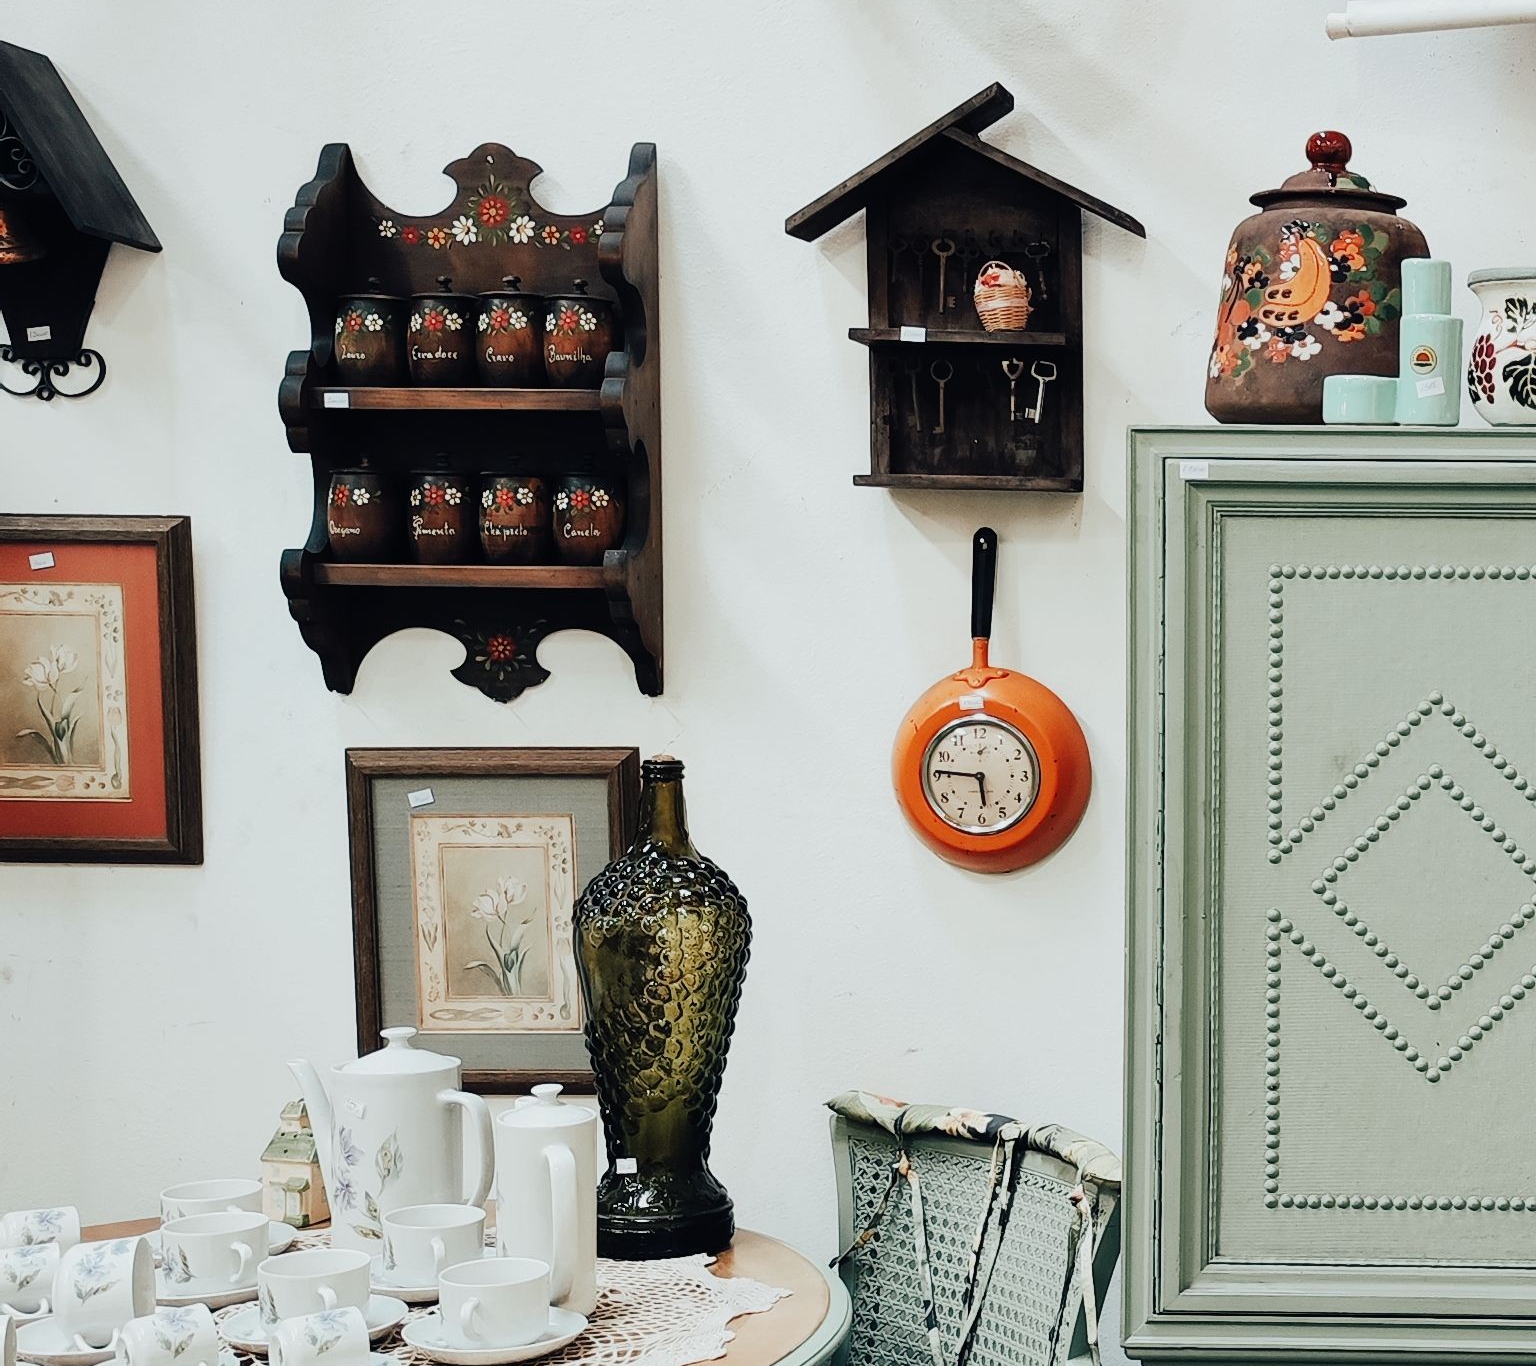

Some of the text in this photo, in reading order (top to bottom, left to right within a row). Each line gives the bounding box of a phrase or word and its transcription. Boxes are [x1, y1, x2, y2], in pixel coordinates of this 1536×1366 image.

[973, 727, 987, 740] 12
[938, 750, 951, 763] 10
[1013, 748, 1022, 761] 2
[932, 770, 942, 782] 9
[1020, 770, 1029, 783] 3
[940, 792, 950, 804] 8
[1013, 792, 1022, 804] 4
[957, 807, 966, 819] 7
[998, 806, 1007, 819] 5
[977, 813, 987, 825] 6
